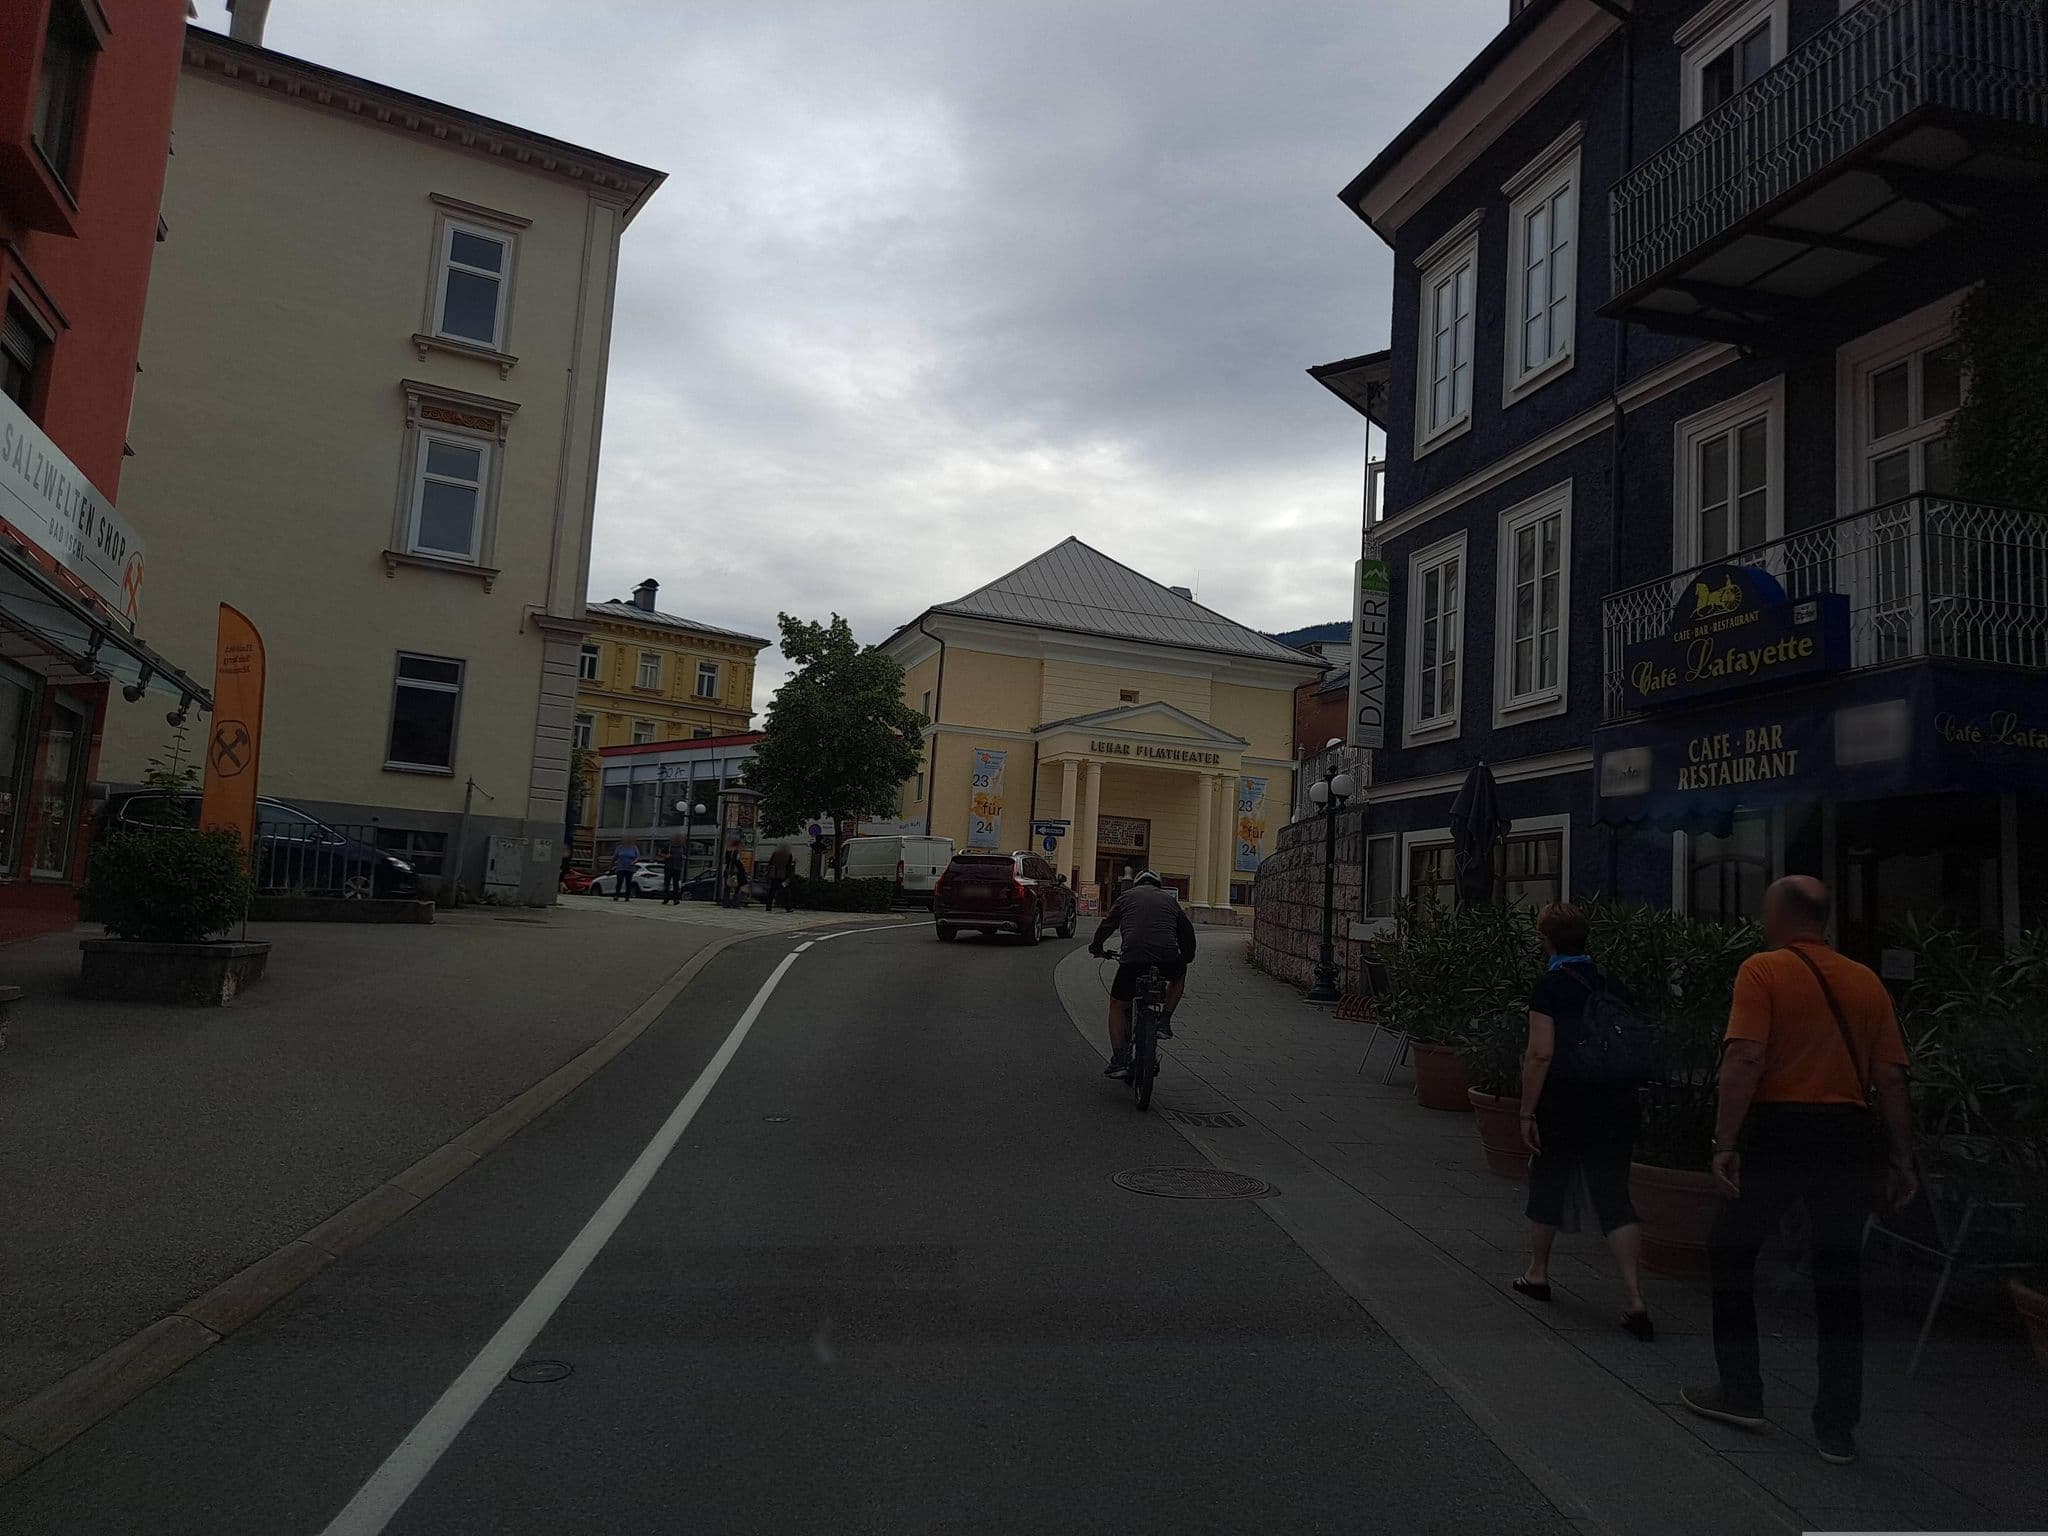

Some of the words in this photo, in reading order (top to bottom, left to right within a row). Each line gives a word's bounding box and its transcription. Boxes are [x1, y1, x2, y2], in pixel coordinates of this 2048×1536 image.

[3, 423, 95, 538] SALZWELTEN
[97, 516, 126, 566] SHOP
[48, 517, 64, 543] BAD
[1712, 610, 1761, 633] RESTAURANT
[1359, 600, 1386, 727] DAXNER
[1631, 660, 1678, 696] Café
[1684, 637, 1815, 682] Lafayette
[1688, 733, 1731, 763] CAFE
[1745, 724, 1784, 754] BAR
[1135, 746, 1220, 764] FILMTHEATER
[973, 774, 989, 787] 23
[1677, 750, 1799, 791] RESTAURANT
[982, 801, 1001, 815] für
[1238, 799, 1252, 812] 23
[976, 821, 993, 834] 24
[1248, 826, 1265, 839] für
[1242, 843, 1257, 857] 24
